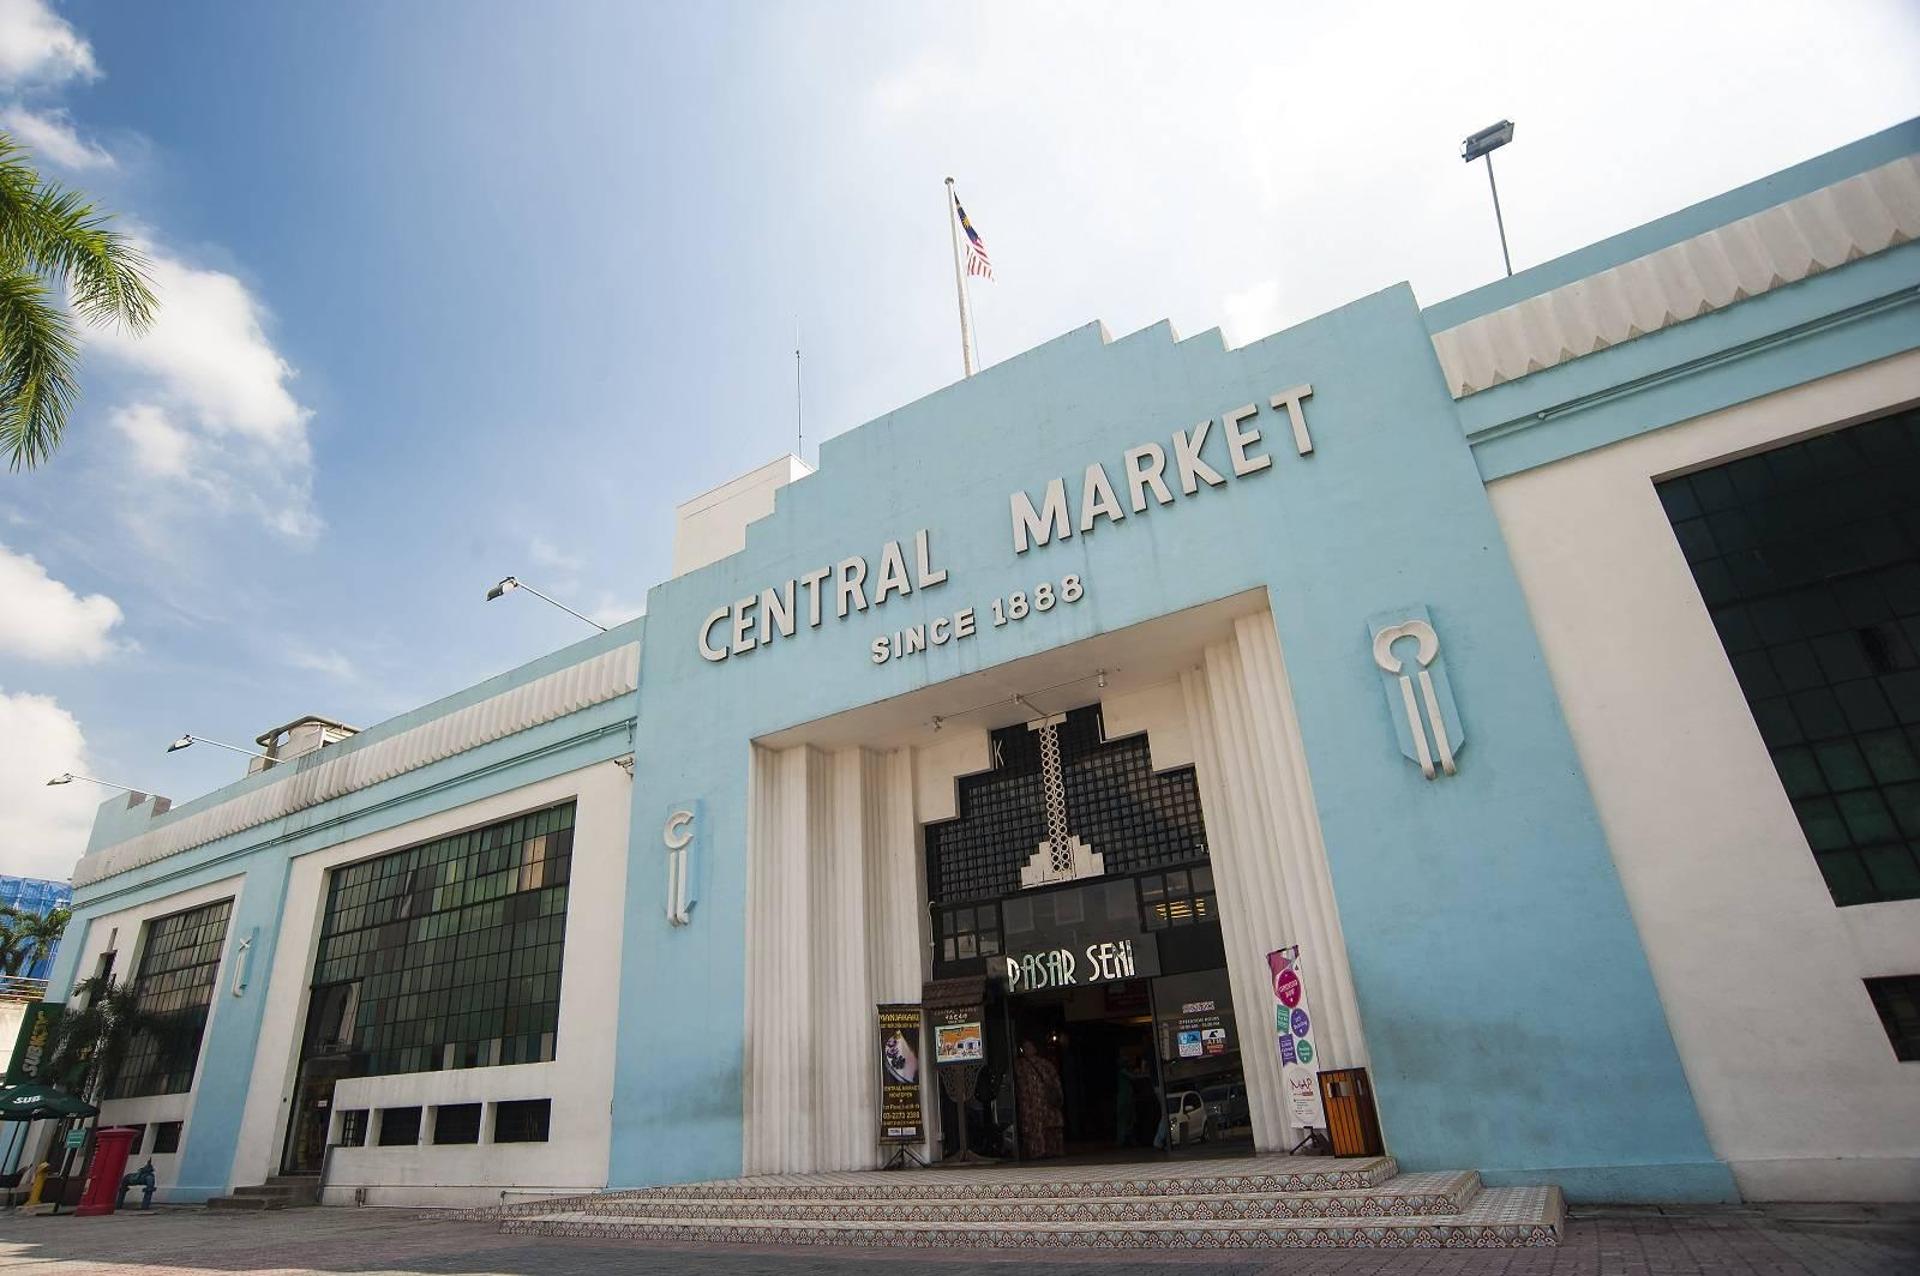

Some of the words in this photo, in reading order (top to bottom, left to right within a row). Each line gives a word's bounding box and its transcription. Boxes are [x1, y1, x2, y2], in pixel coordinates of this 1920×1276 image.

[698, 529, 947, 663] CENTRAL
[1010, 383, 1314, 556] MARKET
[871, 606, 977, 665] SINCE
[992, 573, 1085, 627] 1888
[1006, 948, 1077, 993] PASAR
[1085, 939, 1136, 982] SENI
